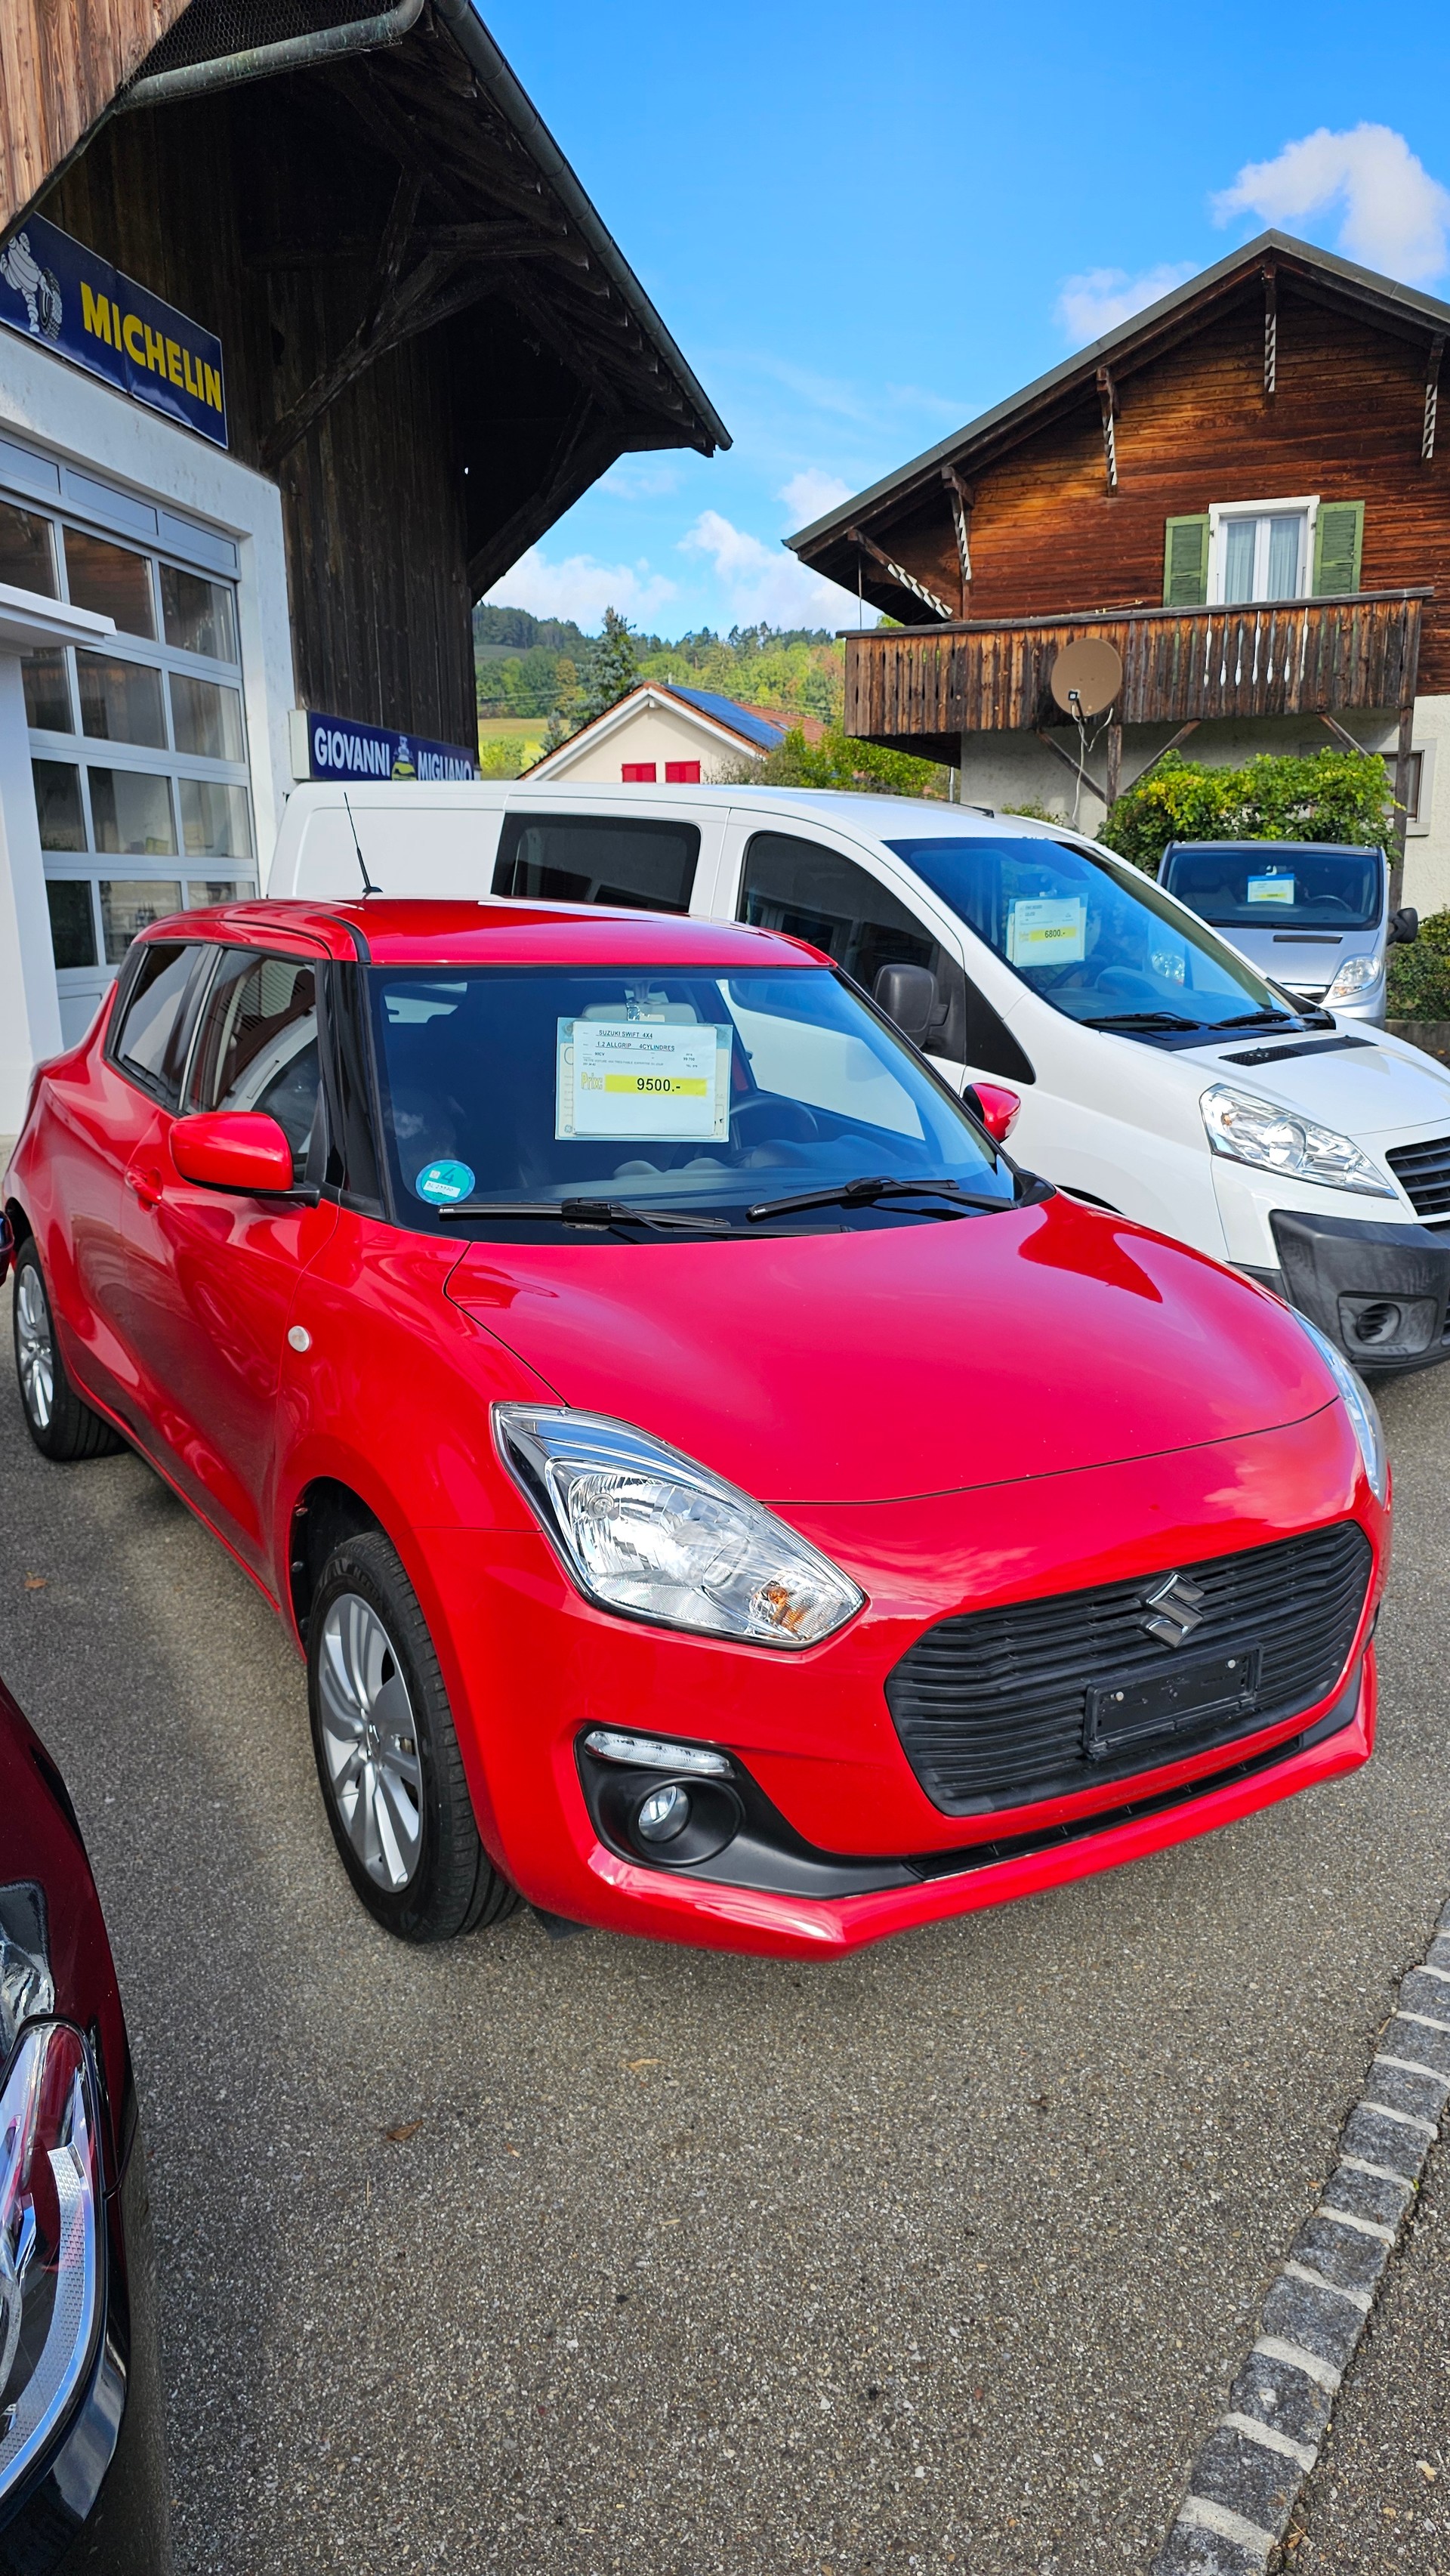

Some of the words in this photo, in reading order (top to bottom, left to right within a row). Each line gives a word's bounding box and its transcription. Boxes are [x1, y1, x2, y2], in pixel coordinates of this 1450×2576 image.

[81, 281, 222, 412] MICHELIN
[314, 727, 390, 777] GIOVANNI
[639, 1043, 675, 1052] 4CYLINDRES
[581, 1071, 603, 1090] Prix:
[637, 1077, 680, 1092] 9500.-
[441, 1167, 456, 1184] 4
